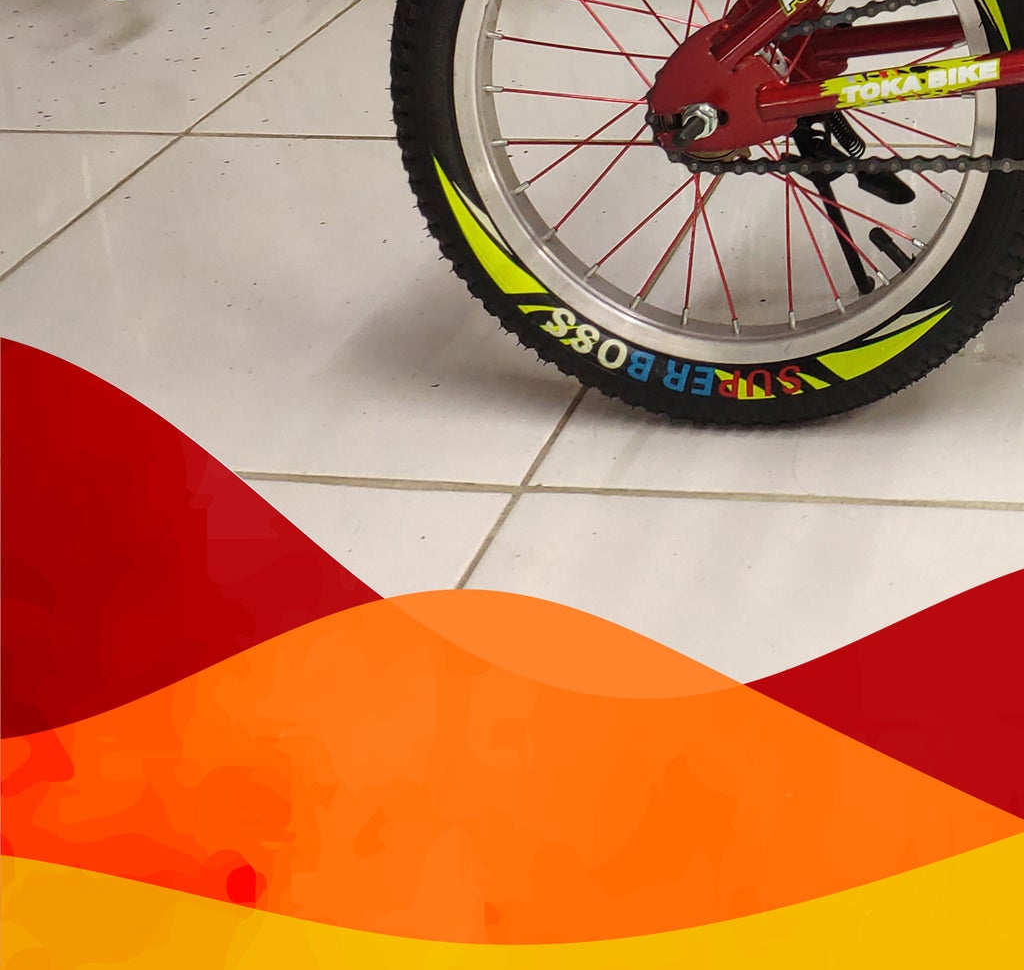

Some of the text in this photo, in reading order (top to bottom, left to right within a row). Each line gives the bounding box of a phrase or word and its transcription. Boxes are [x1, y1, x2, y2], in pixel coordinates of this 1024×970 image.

[840, 61, 999, 105] TOKA BIKE
[545, 307, 803, 398] SUPER BOSS
